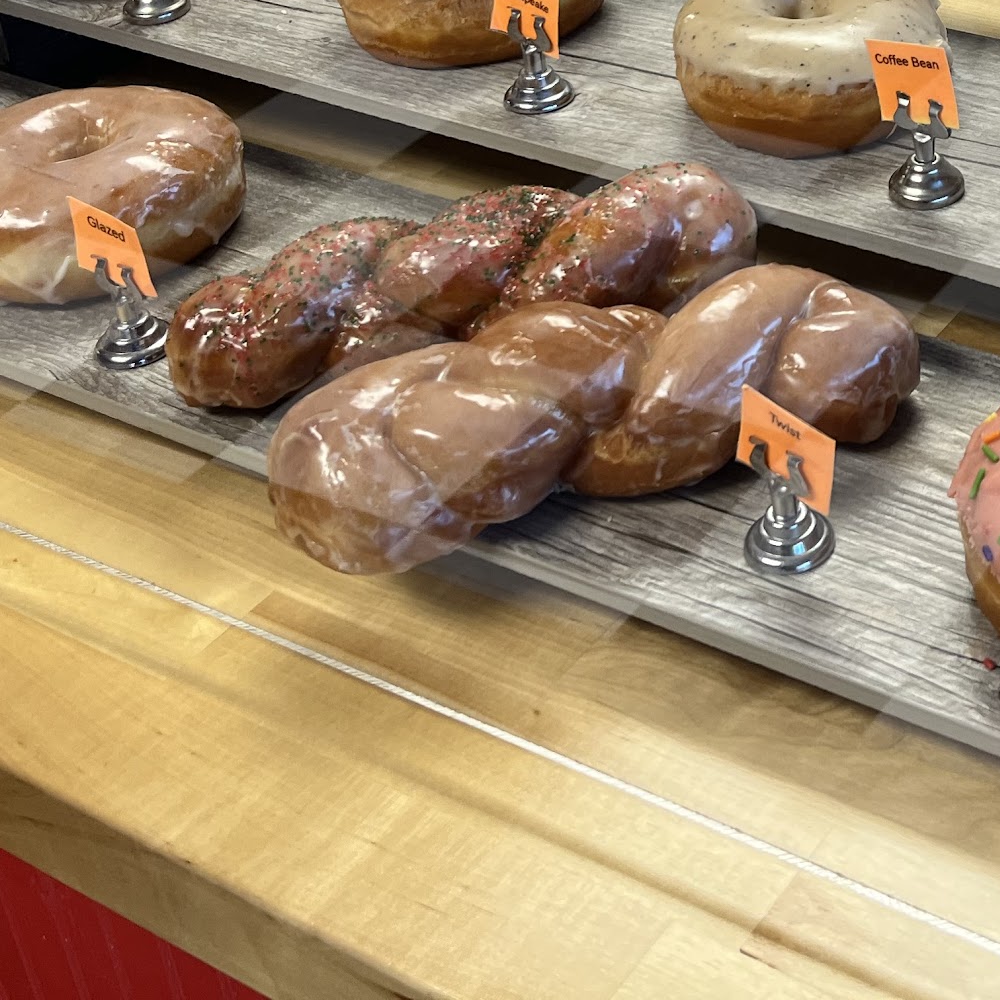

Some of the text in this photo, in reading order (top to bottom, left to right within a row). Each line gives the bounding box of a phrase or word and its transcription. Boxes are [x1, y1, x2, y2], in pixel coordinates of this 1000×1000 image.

[875, 53, 940, 70] Coffee Bean
[87, 215, 126, 242] Glazed
[769, 411, 802, 440] Twist
